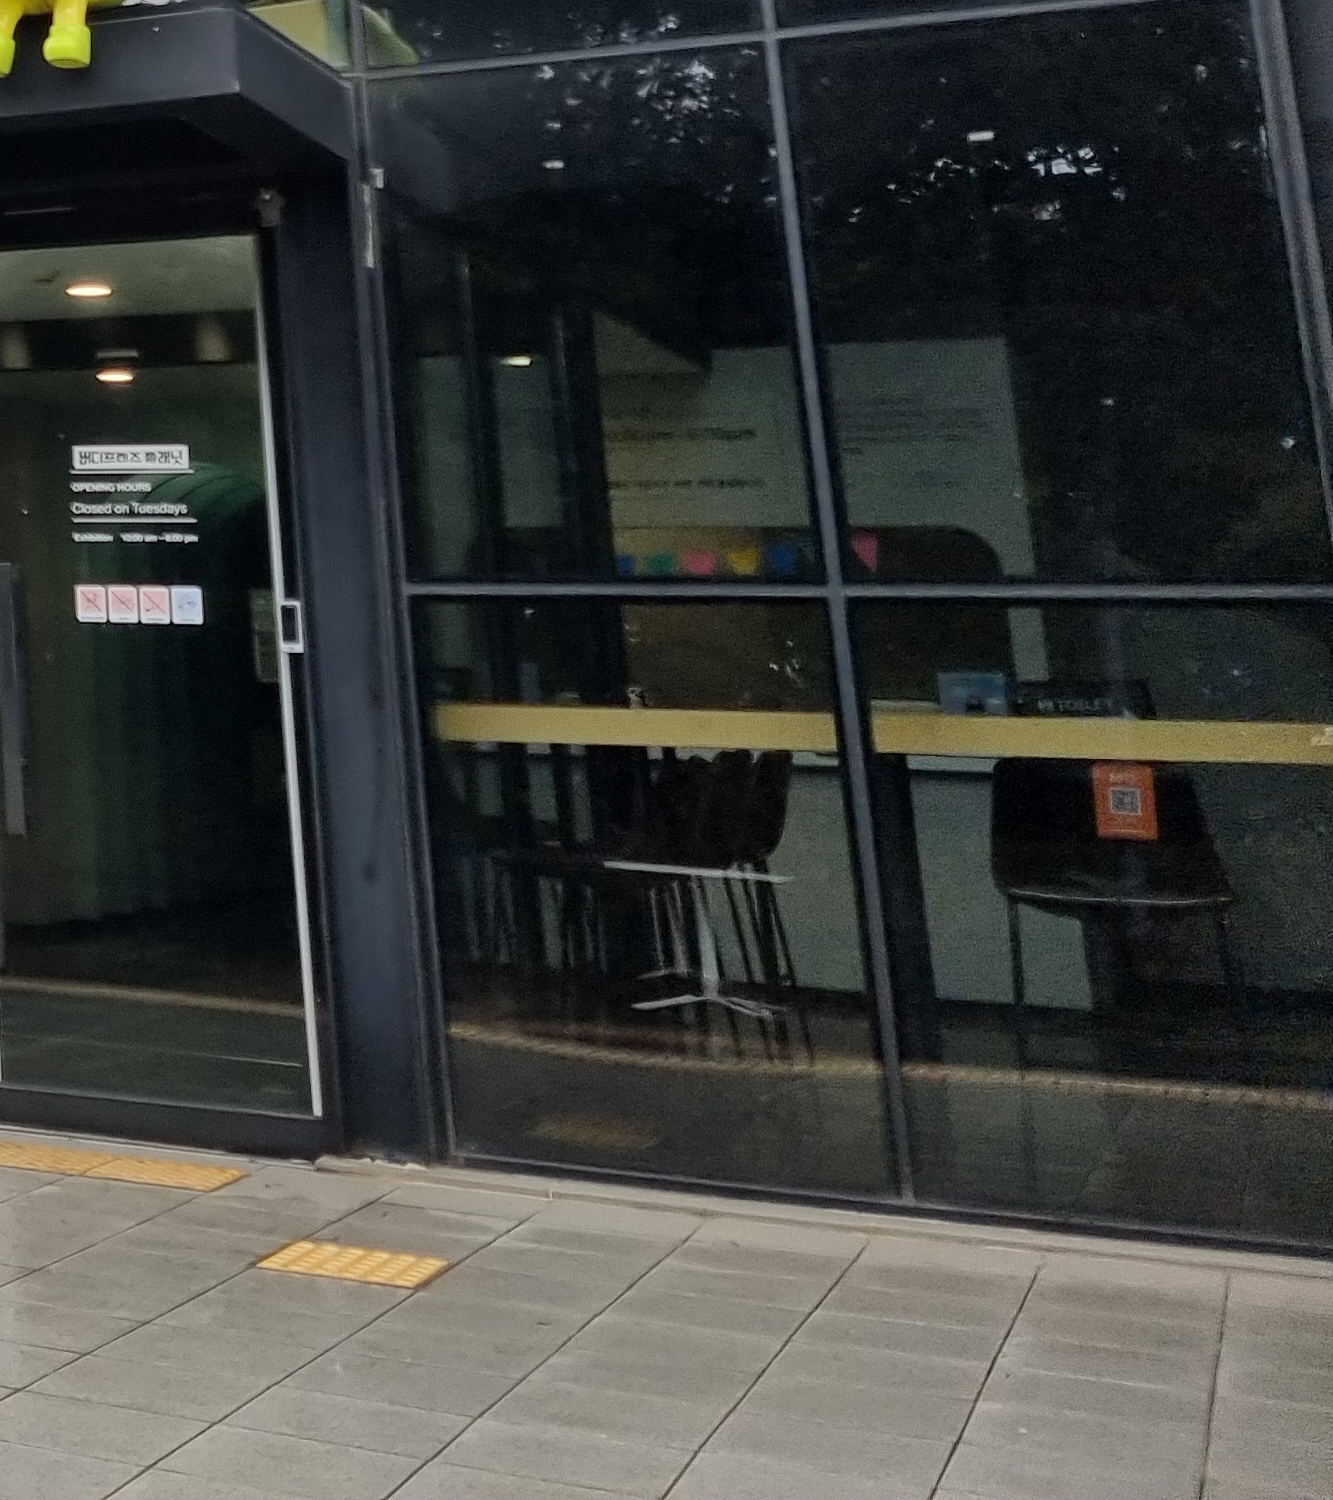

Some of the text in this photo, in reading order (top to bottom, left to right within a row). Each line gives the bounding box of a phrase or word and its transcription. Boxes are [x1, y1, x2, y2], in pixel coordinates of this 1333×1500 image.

[116, 481, 152, 493] HOURS
[70, 501, 188, 517] Closed on Tuesdays
